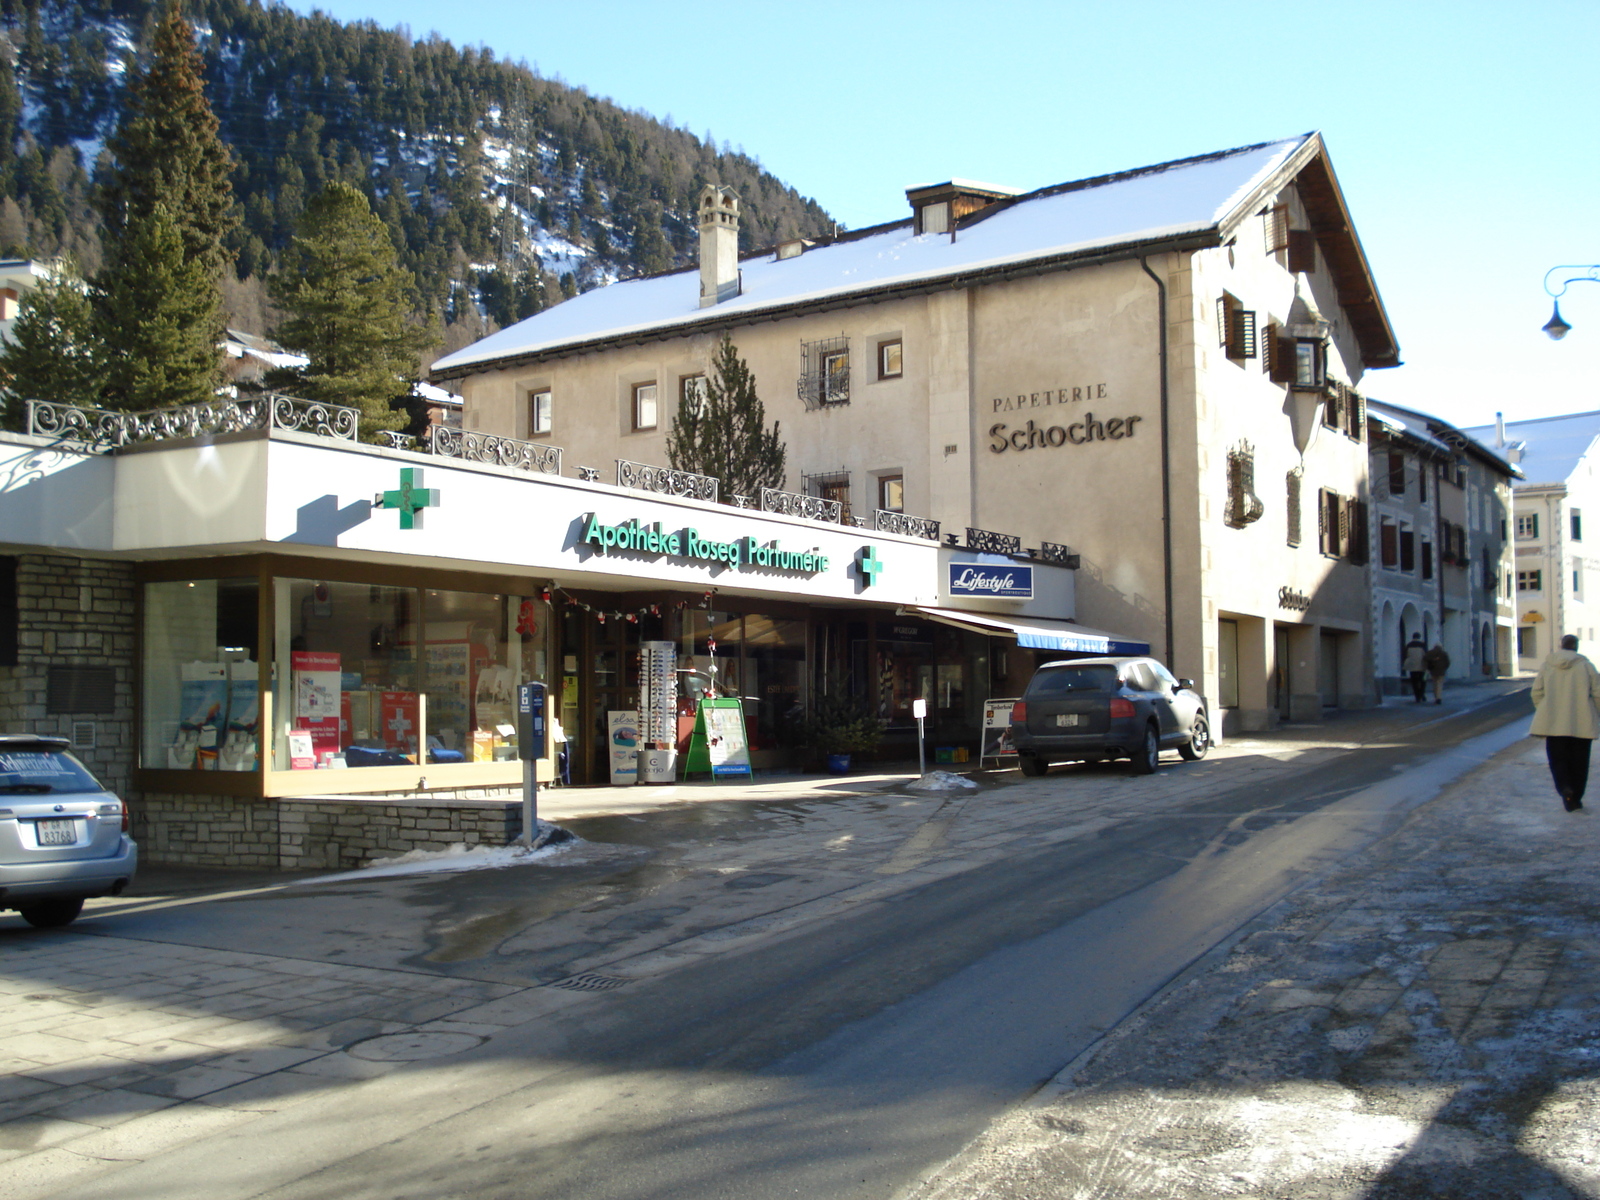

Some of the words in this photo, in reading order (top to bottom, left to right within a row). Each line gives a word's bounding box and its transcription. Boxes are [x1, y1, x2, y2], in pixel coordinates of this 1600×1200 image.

[992, 383, 1108, 413] PAPETERIE
[988, 412, 1142, 454] Schocher
[582, 512, 681, 556] Apotheke
[684, 527, 740, 569] Roseg
[745, 536, 830, 573] Parfumerie
[953, 568, 1015, 593] Lifestyle
[44, 831, 72, 844] 83768
